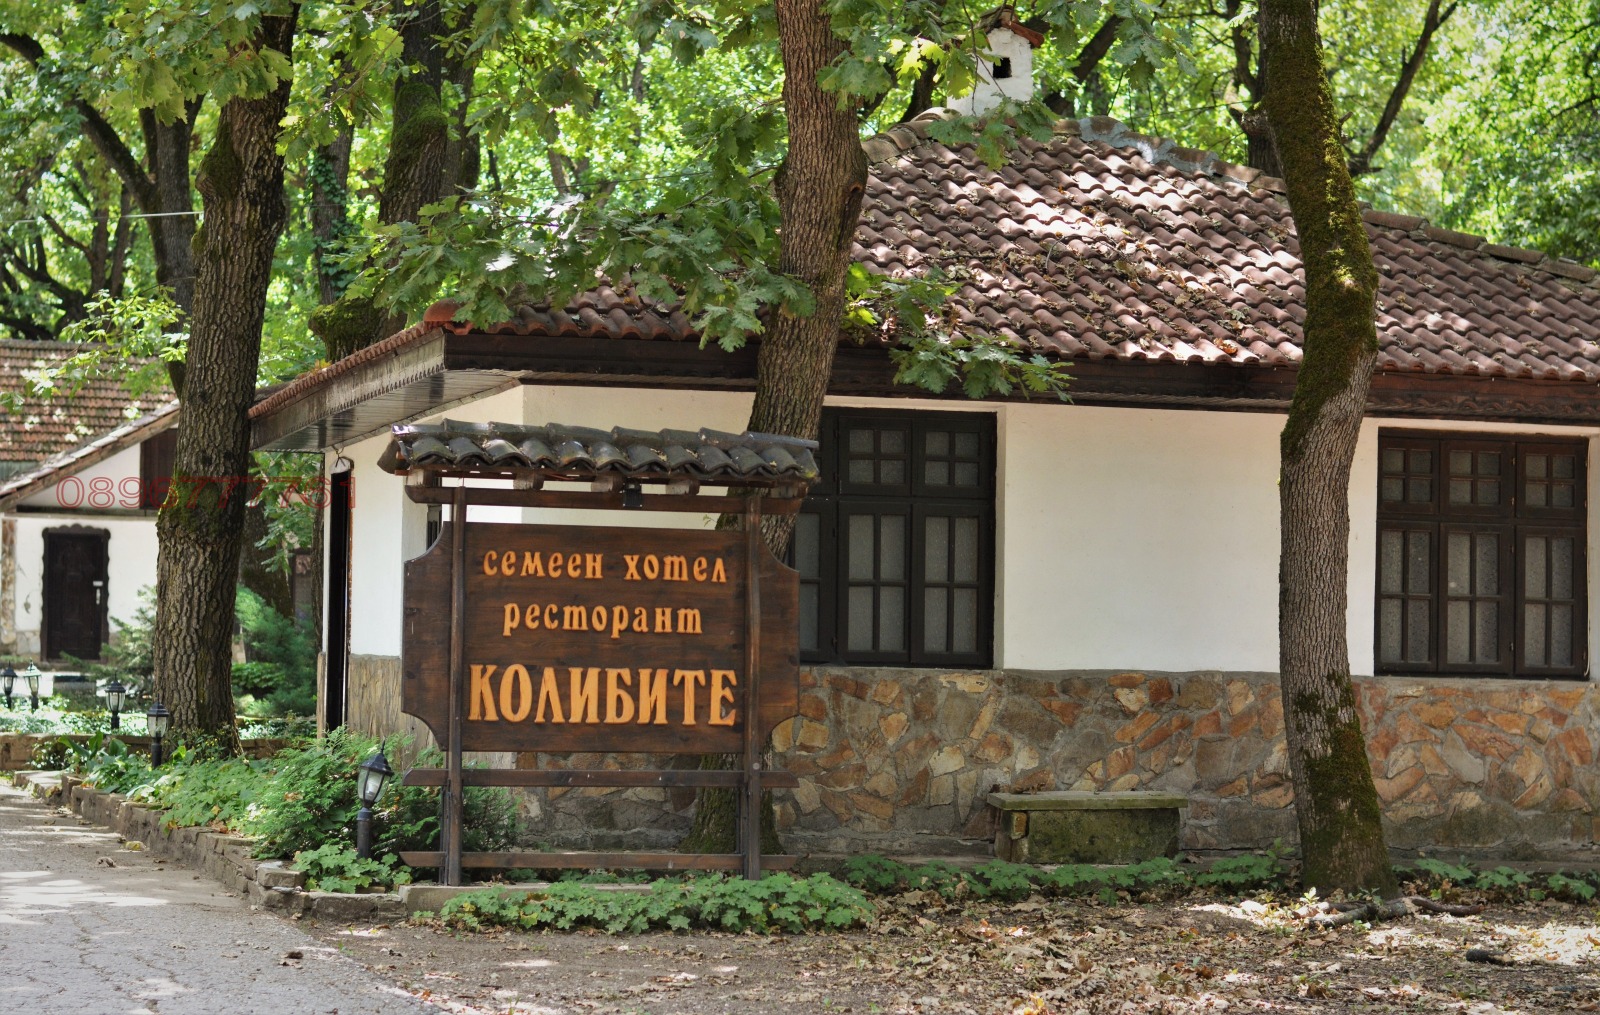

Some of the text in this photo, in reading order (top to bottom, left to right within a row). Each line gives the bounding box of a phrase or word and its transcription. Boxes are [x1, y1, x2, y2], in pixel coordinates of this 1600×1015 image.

[484, 550, 727, 583] семеен хотел
[503, 602, 703, 639] ресторант
[468, 663, 738, 727] КОЛИБИТЕ
